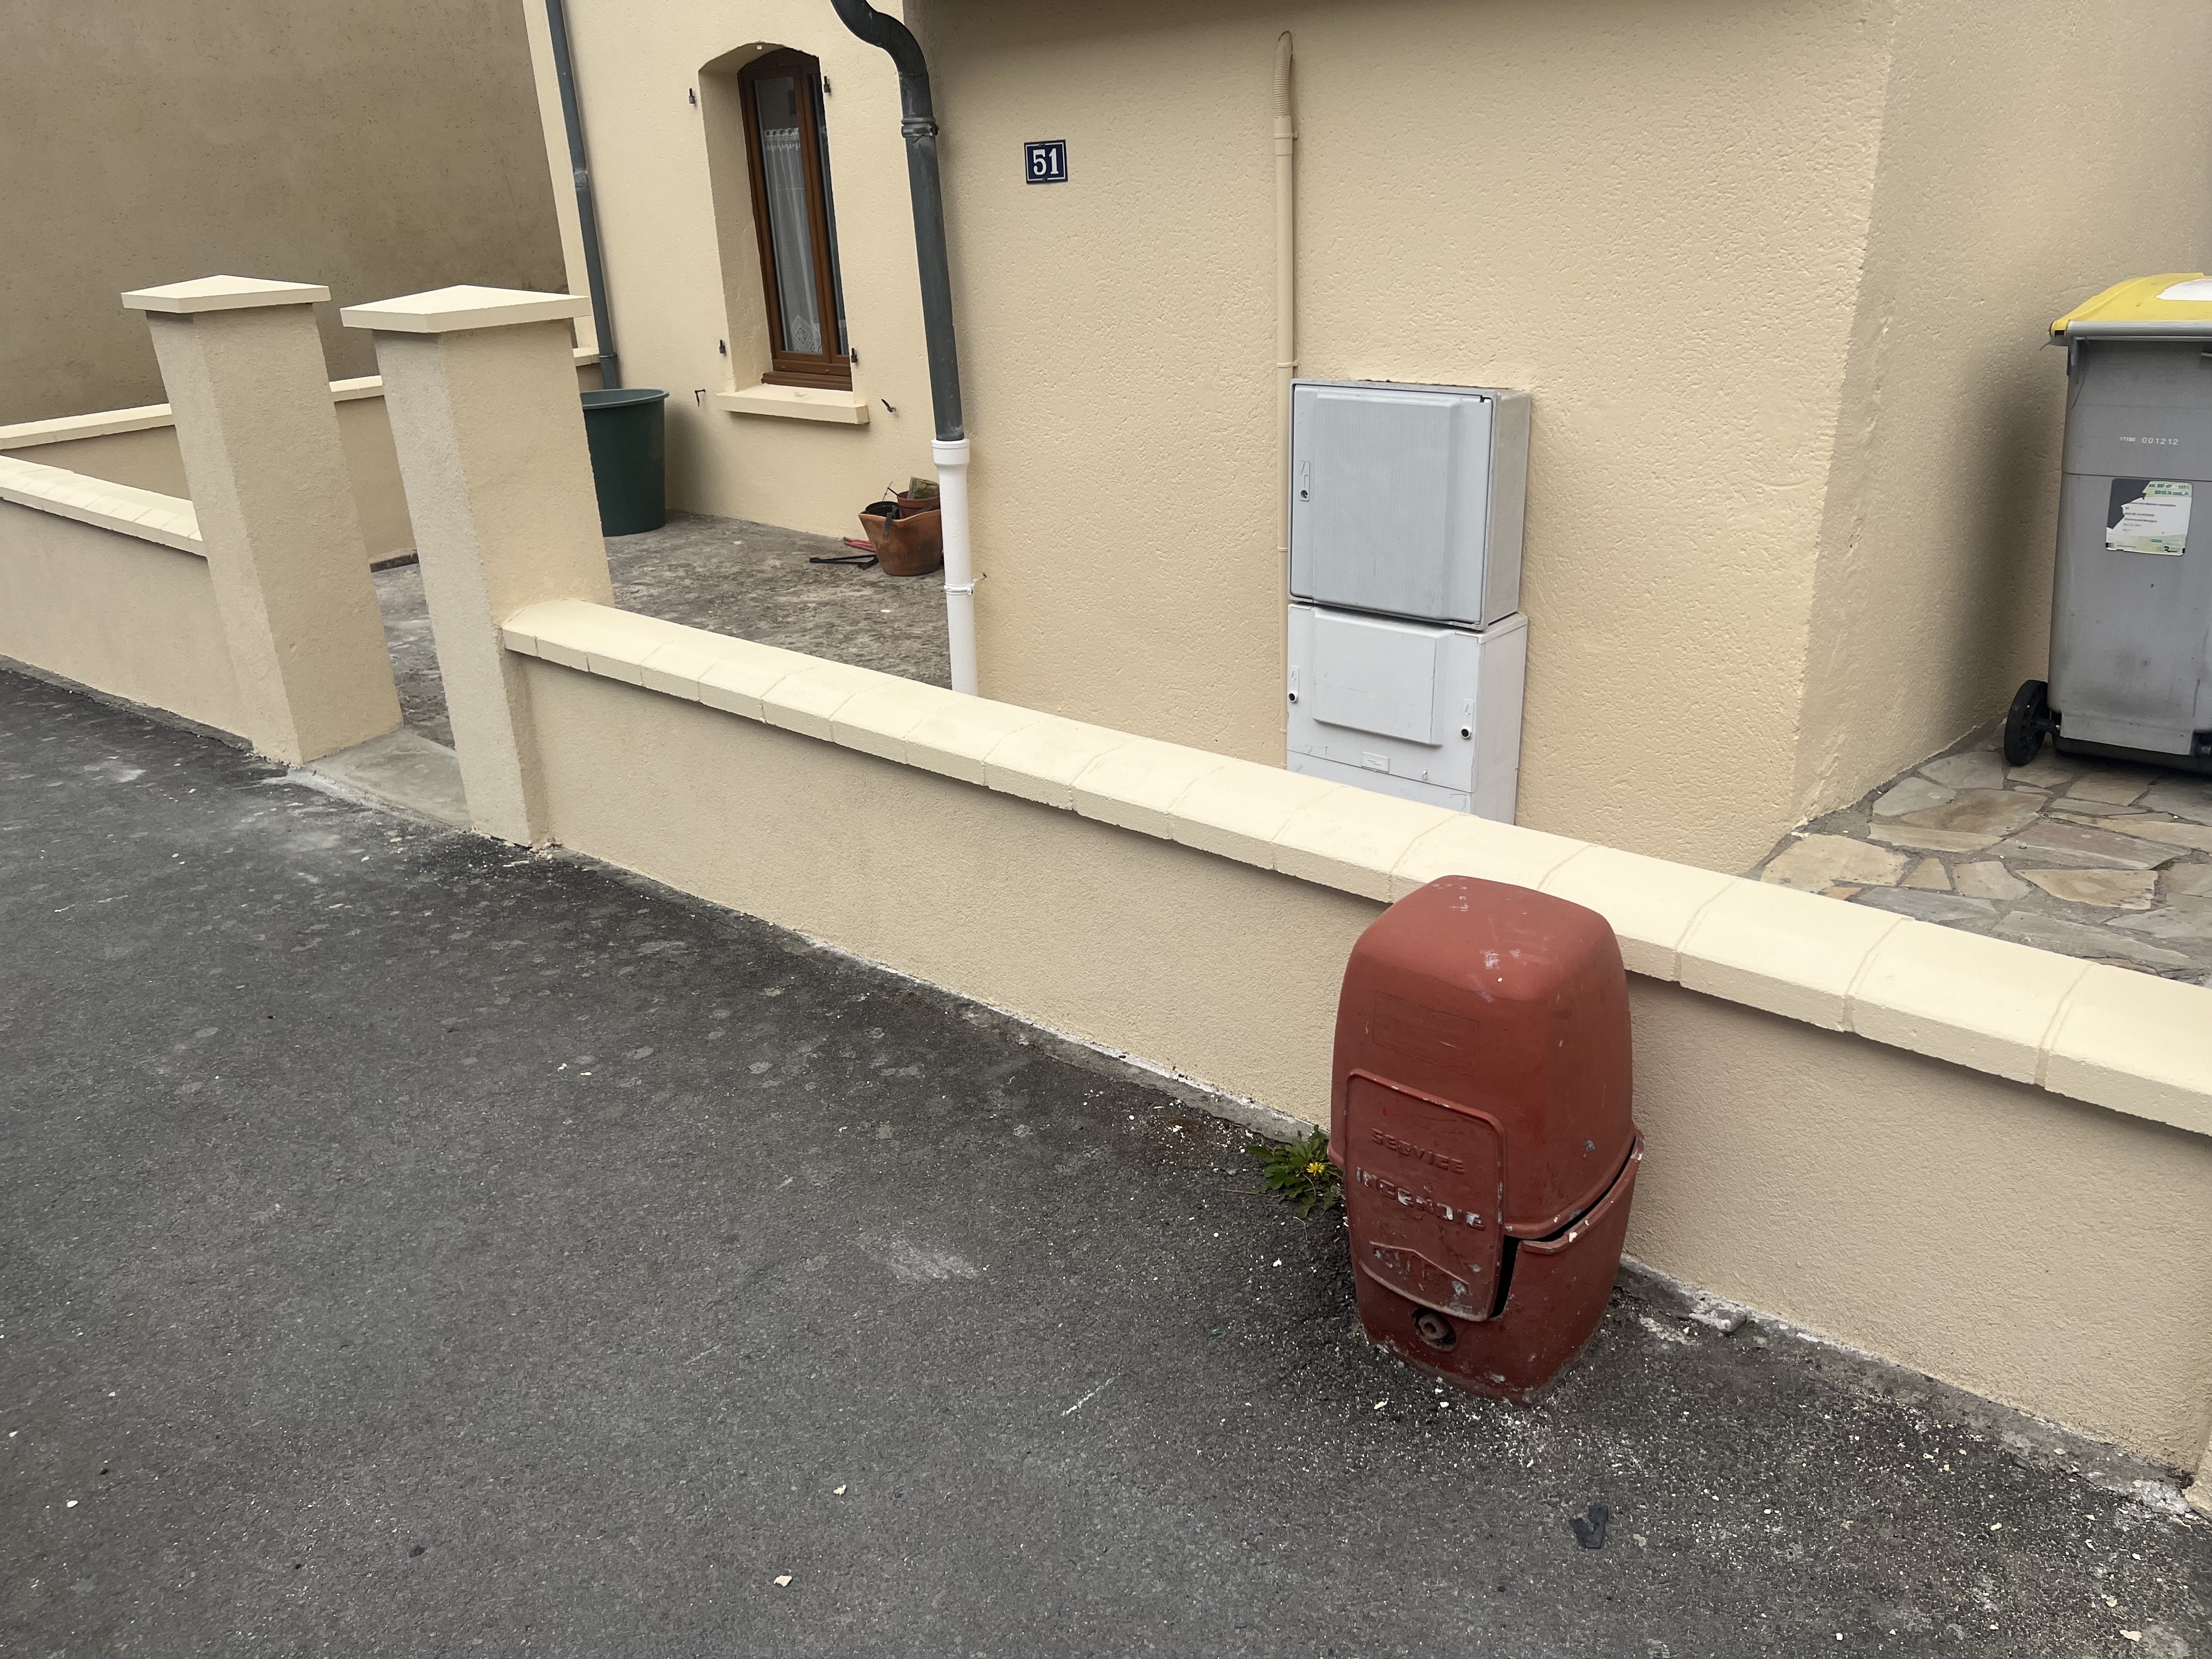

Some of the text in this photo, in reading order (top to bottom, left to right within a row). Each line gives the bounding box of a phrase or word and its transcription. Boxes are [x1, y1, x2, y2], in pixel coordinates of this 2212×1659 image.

[1032, 148, 1059, 176] 51
[2142, 437, 2179, 445] 001212
[1372, 1127, 1465, 1175] SERVICE
[1356, 1166, 1486, 1231] INCENDIE
